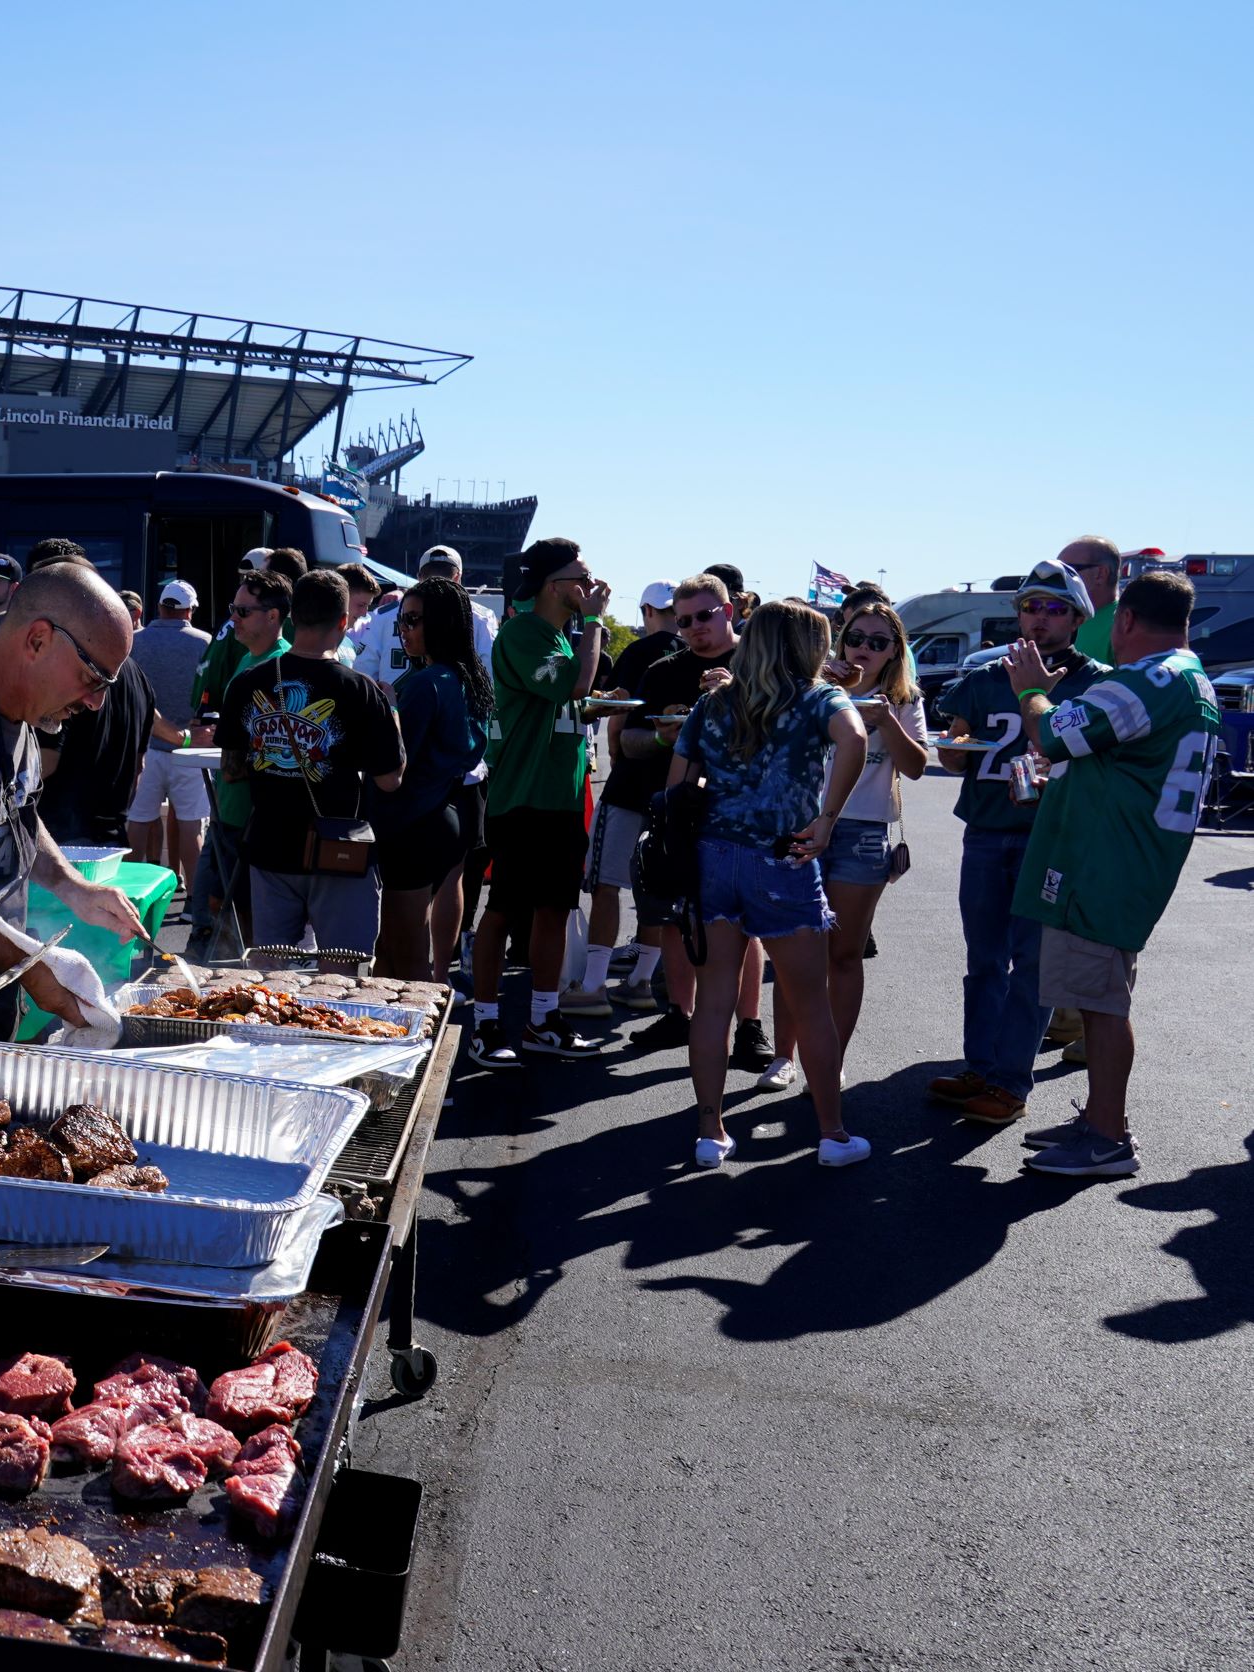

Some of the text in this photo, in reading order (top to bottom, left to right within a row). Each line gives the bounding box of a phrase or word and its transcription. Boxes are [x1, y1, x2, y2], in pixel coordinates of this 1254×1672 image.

[58, 410, 131, 429] Financial
[133, 413, 174, 430] Field
[264, 737, 308, 751] SURFBODS
